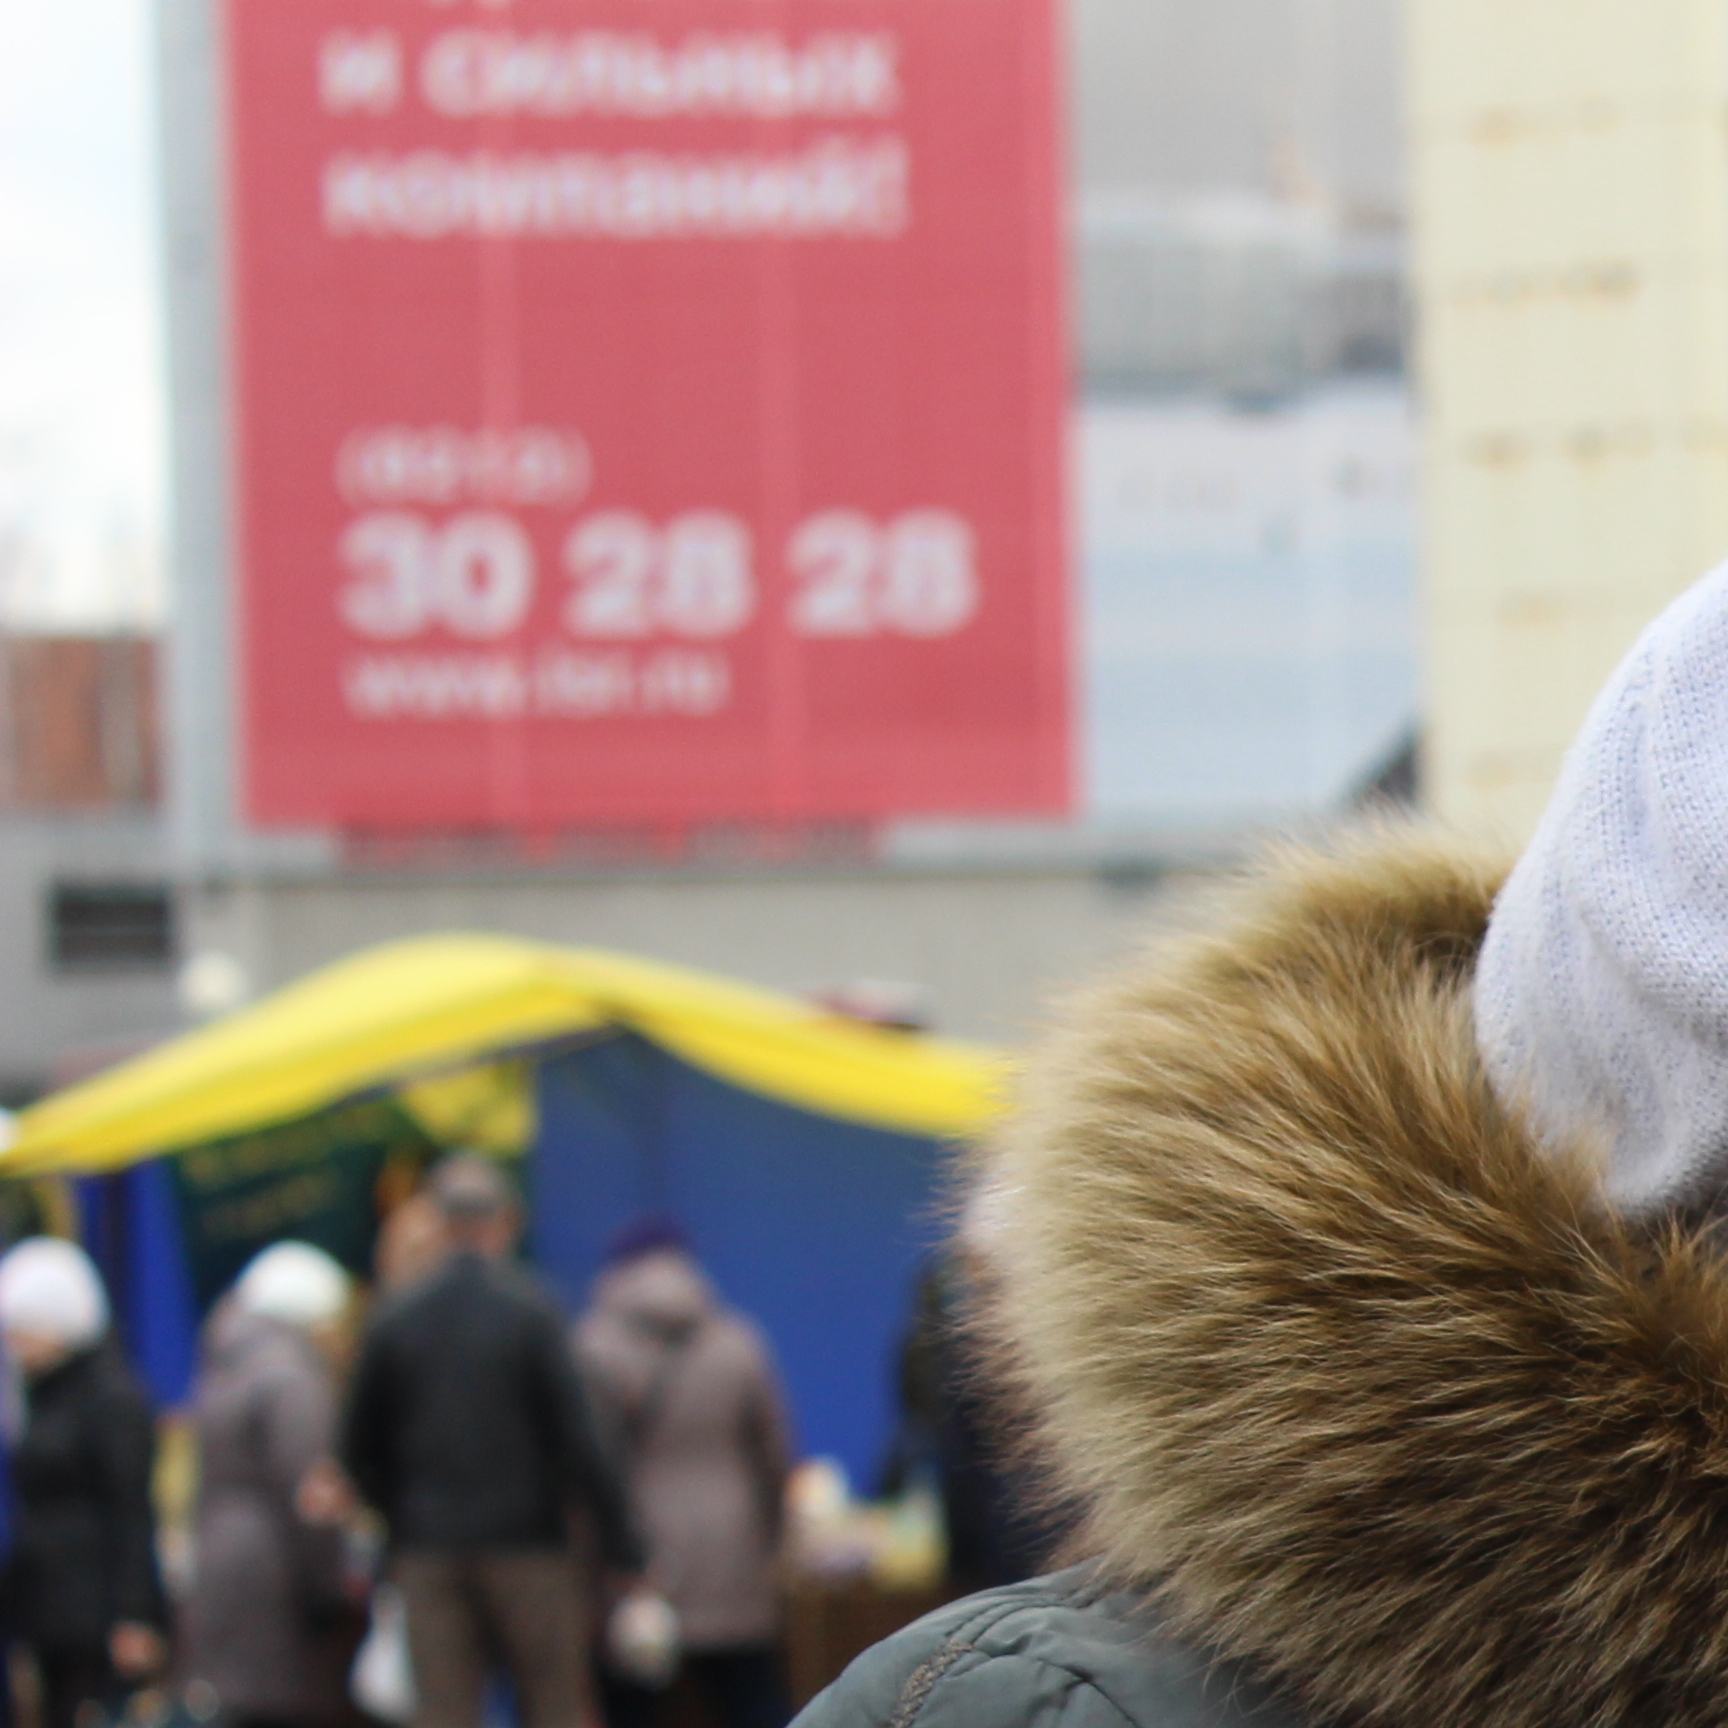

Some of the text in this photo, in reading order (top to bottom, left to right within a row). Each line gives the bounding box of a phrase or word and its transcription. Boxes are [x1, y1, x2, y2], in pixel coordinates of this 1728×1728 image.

[420, 28, 902, 118] сильных
[321, 134, 910, 240] компаний!
[337, 508, 982, 641] 30 28 28
